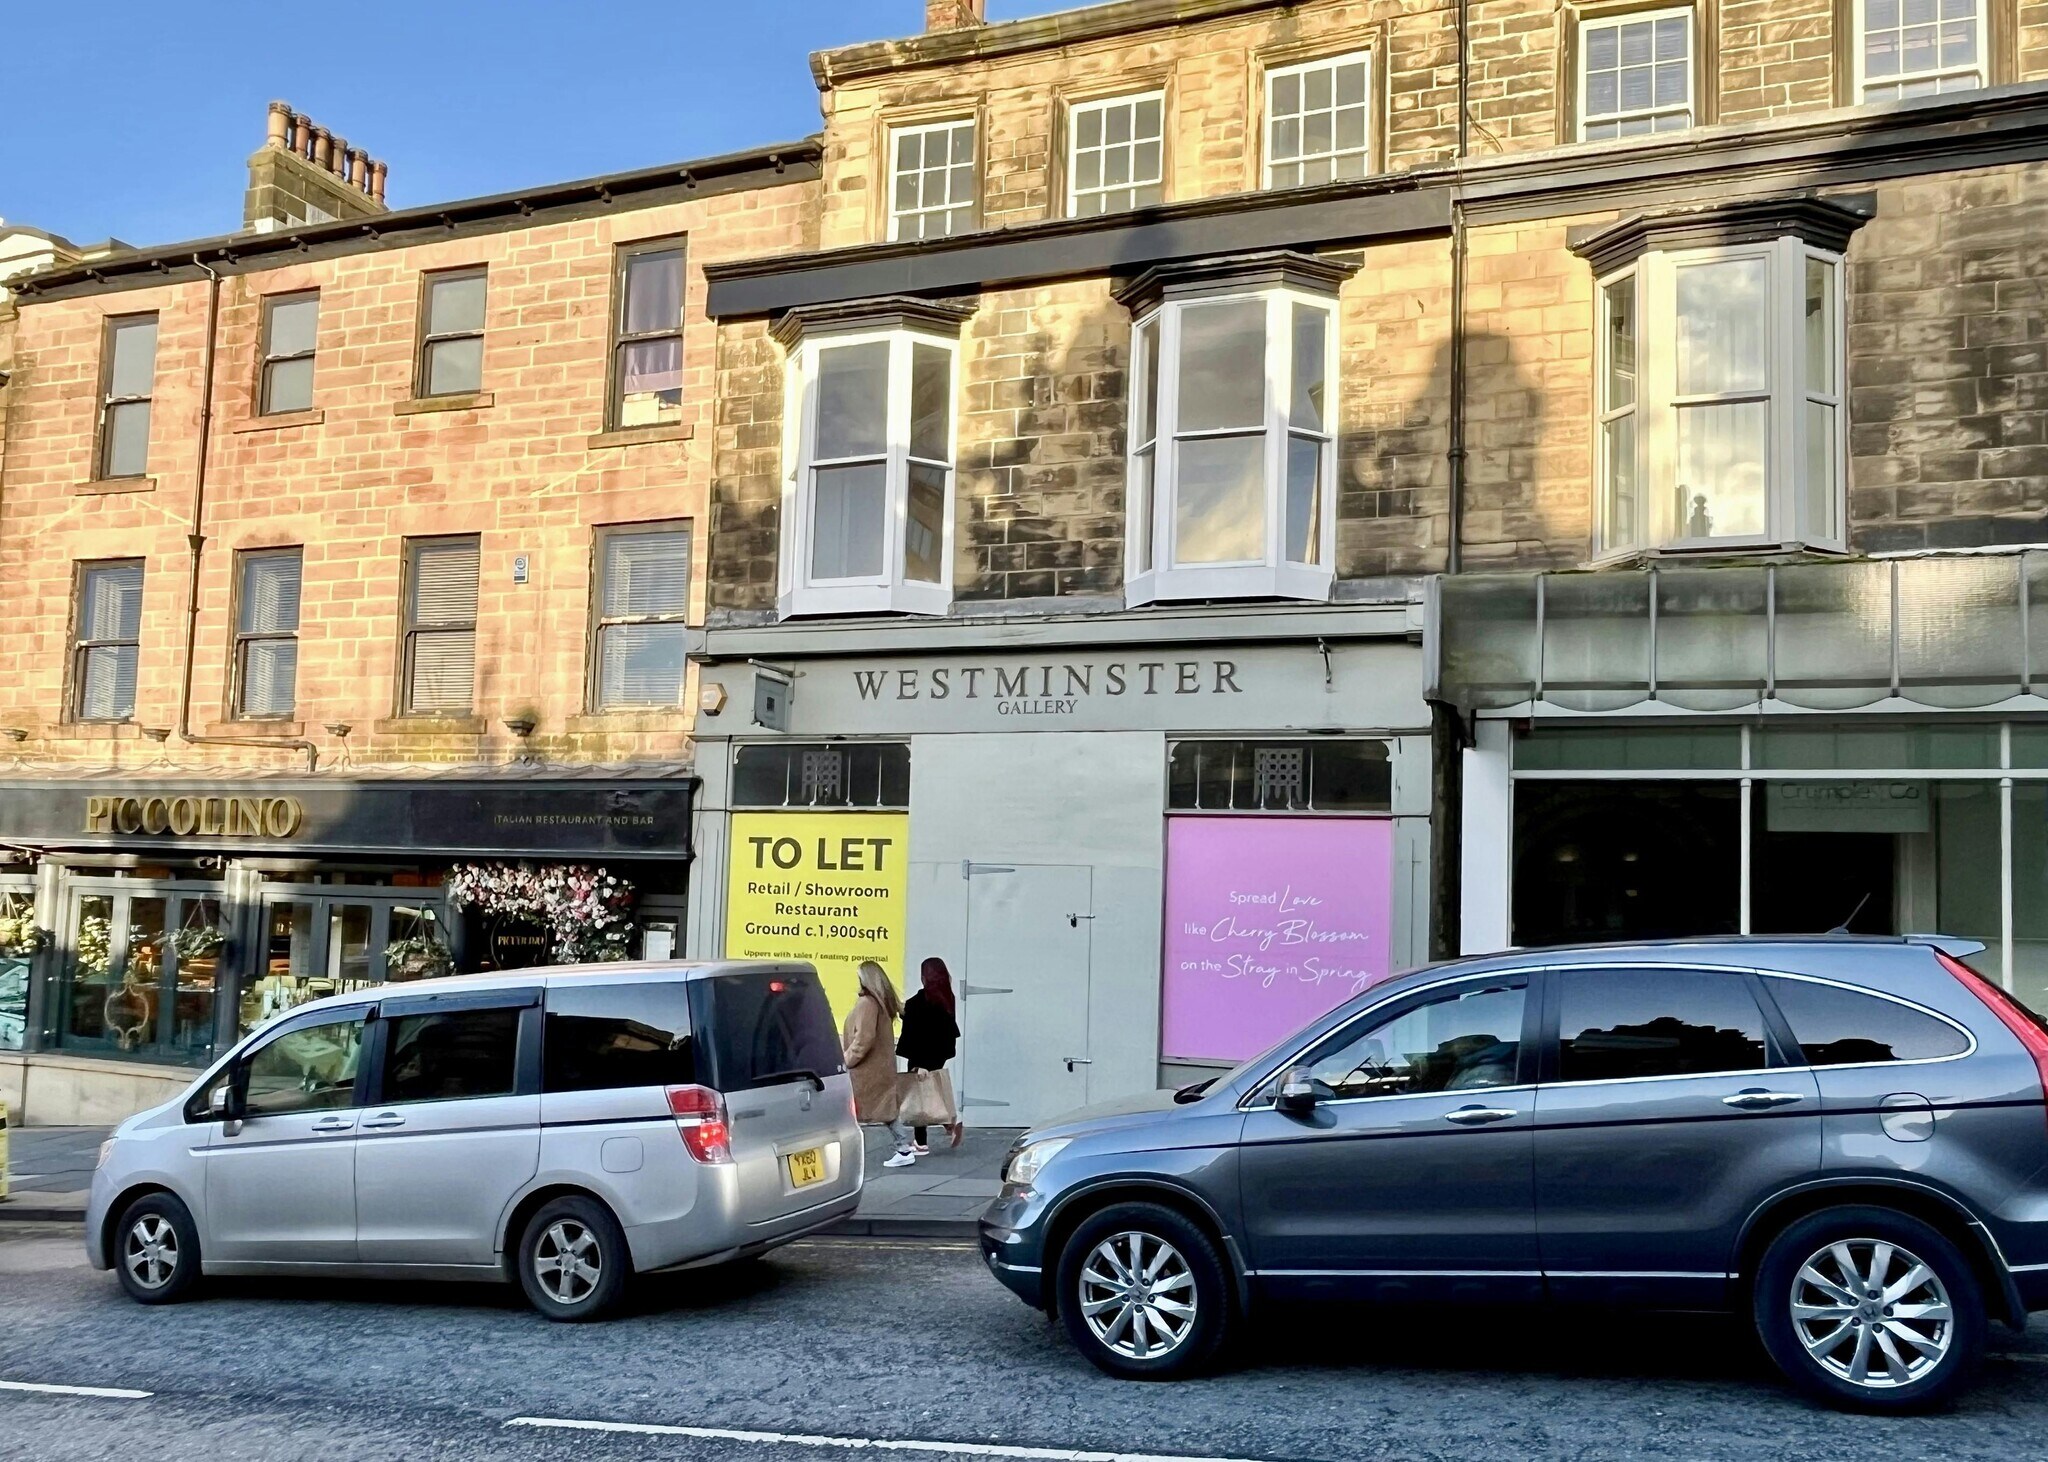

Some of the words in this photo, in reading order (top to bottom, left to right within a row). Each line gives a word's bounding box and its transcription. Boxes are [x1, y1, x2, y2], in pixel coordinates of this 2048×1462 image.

[853, 660, 1244, 701] WESTMINSTER
[997, 699, 1079, 716] GALLERY
[82, 795, 303, 839] PICCOLINO
[494, 814, 533, 825] ITALIAN
[535, 815, 603, 826] RESTAURANT
[605, 816, 629, 826] AND
[632, 816, 655, 826] BAR
[748, 836, 803, 870] TO
[817, 837, 893, 872] LET
[747, 881, 791, 896] Retail
[794, 880, 802, 898] /
[804, 882, 890, 899] Showroom
[1229, 890, 1277, 906] Spread
[1279, 884, 1324, 913] Love
[775, 902, 859, 918] Restaurant
[745, 922, 800, 937] Ground
[805, 924, 890, 943] c.1,900sqft
[1184, 922, 1208, 936] like
[1210, 915, 1279, 952] Cherry
[1276, 919, 1370, 946] Blossom
[744, 949, 772, 959] Uppers
[773, 950, 792, 959] with
[793, 951, 813, 960] sales
[1180, 961, 1198, 972] on
[1200, 959, 1223, 972] the
[1221, 953, 1282, 989] Stray
[1285, 962, 1299, 976] in
[1298, 956, 1374, 994] Spring
